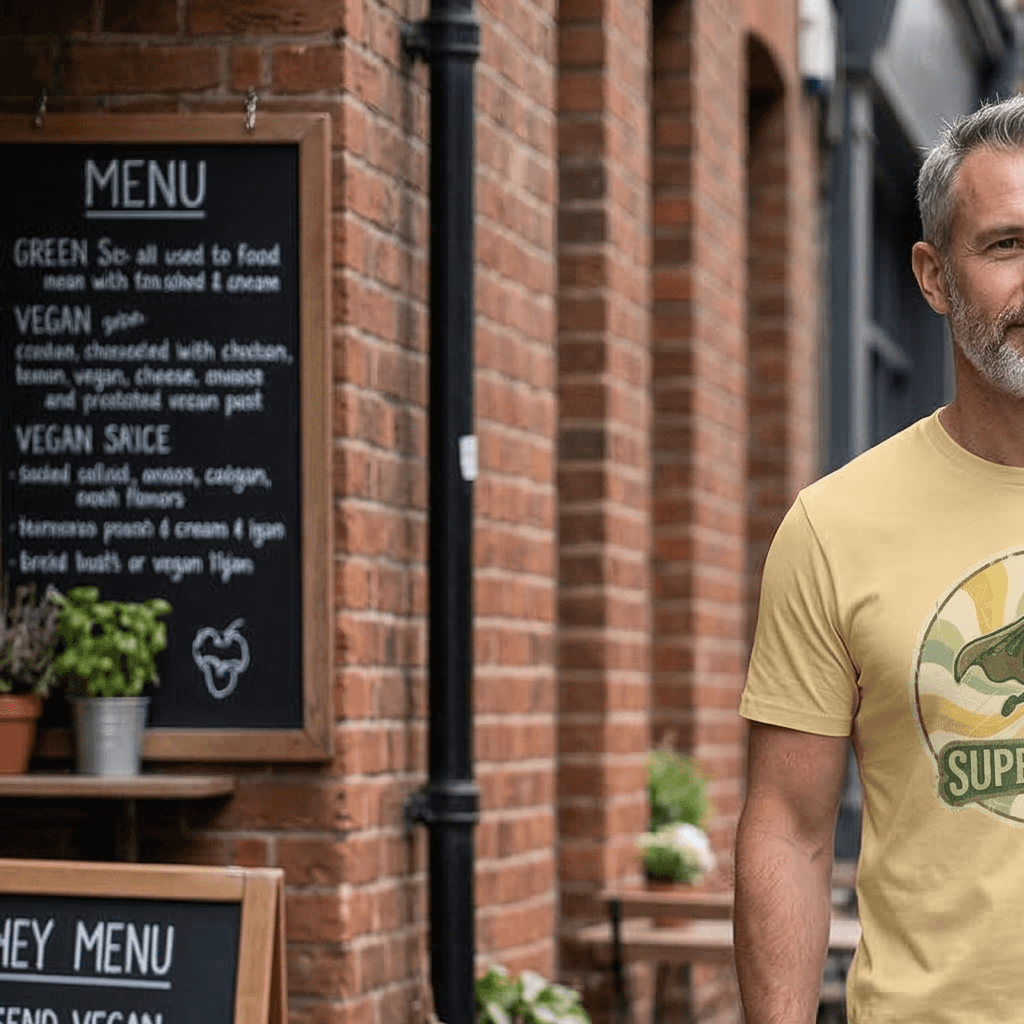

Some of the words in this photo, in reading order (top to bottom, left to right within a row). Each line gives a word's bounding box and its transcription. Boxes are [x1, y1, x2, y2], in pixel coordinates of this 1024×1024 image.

[85, 159, 207, 209] MENU
[14, 237, 89, 267] GREEN
[135, 244, 158, 266] all
[211, 244, 232, 266] to
[14, 304, 92, 335] VEGAN
[15, 423, 93, 454] VEGAN
[71, 921, 174, 976] MENU
